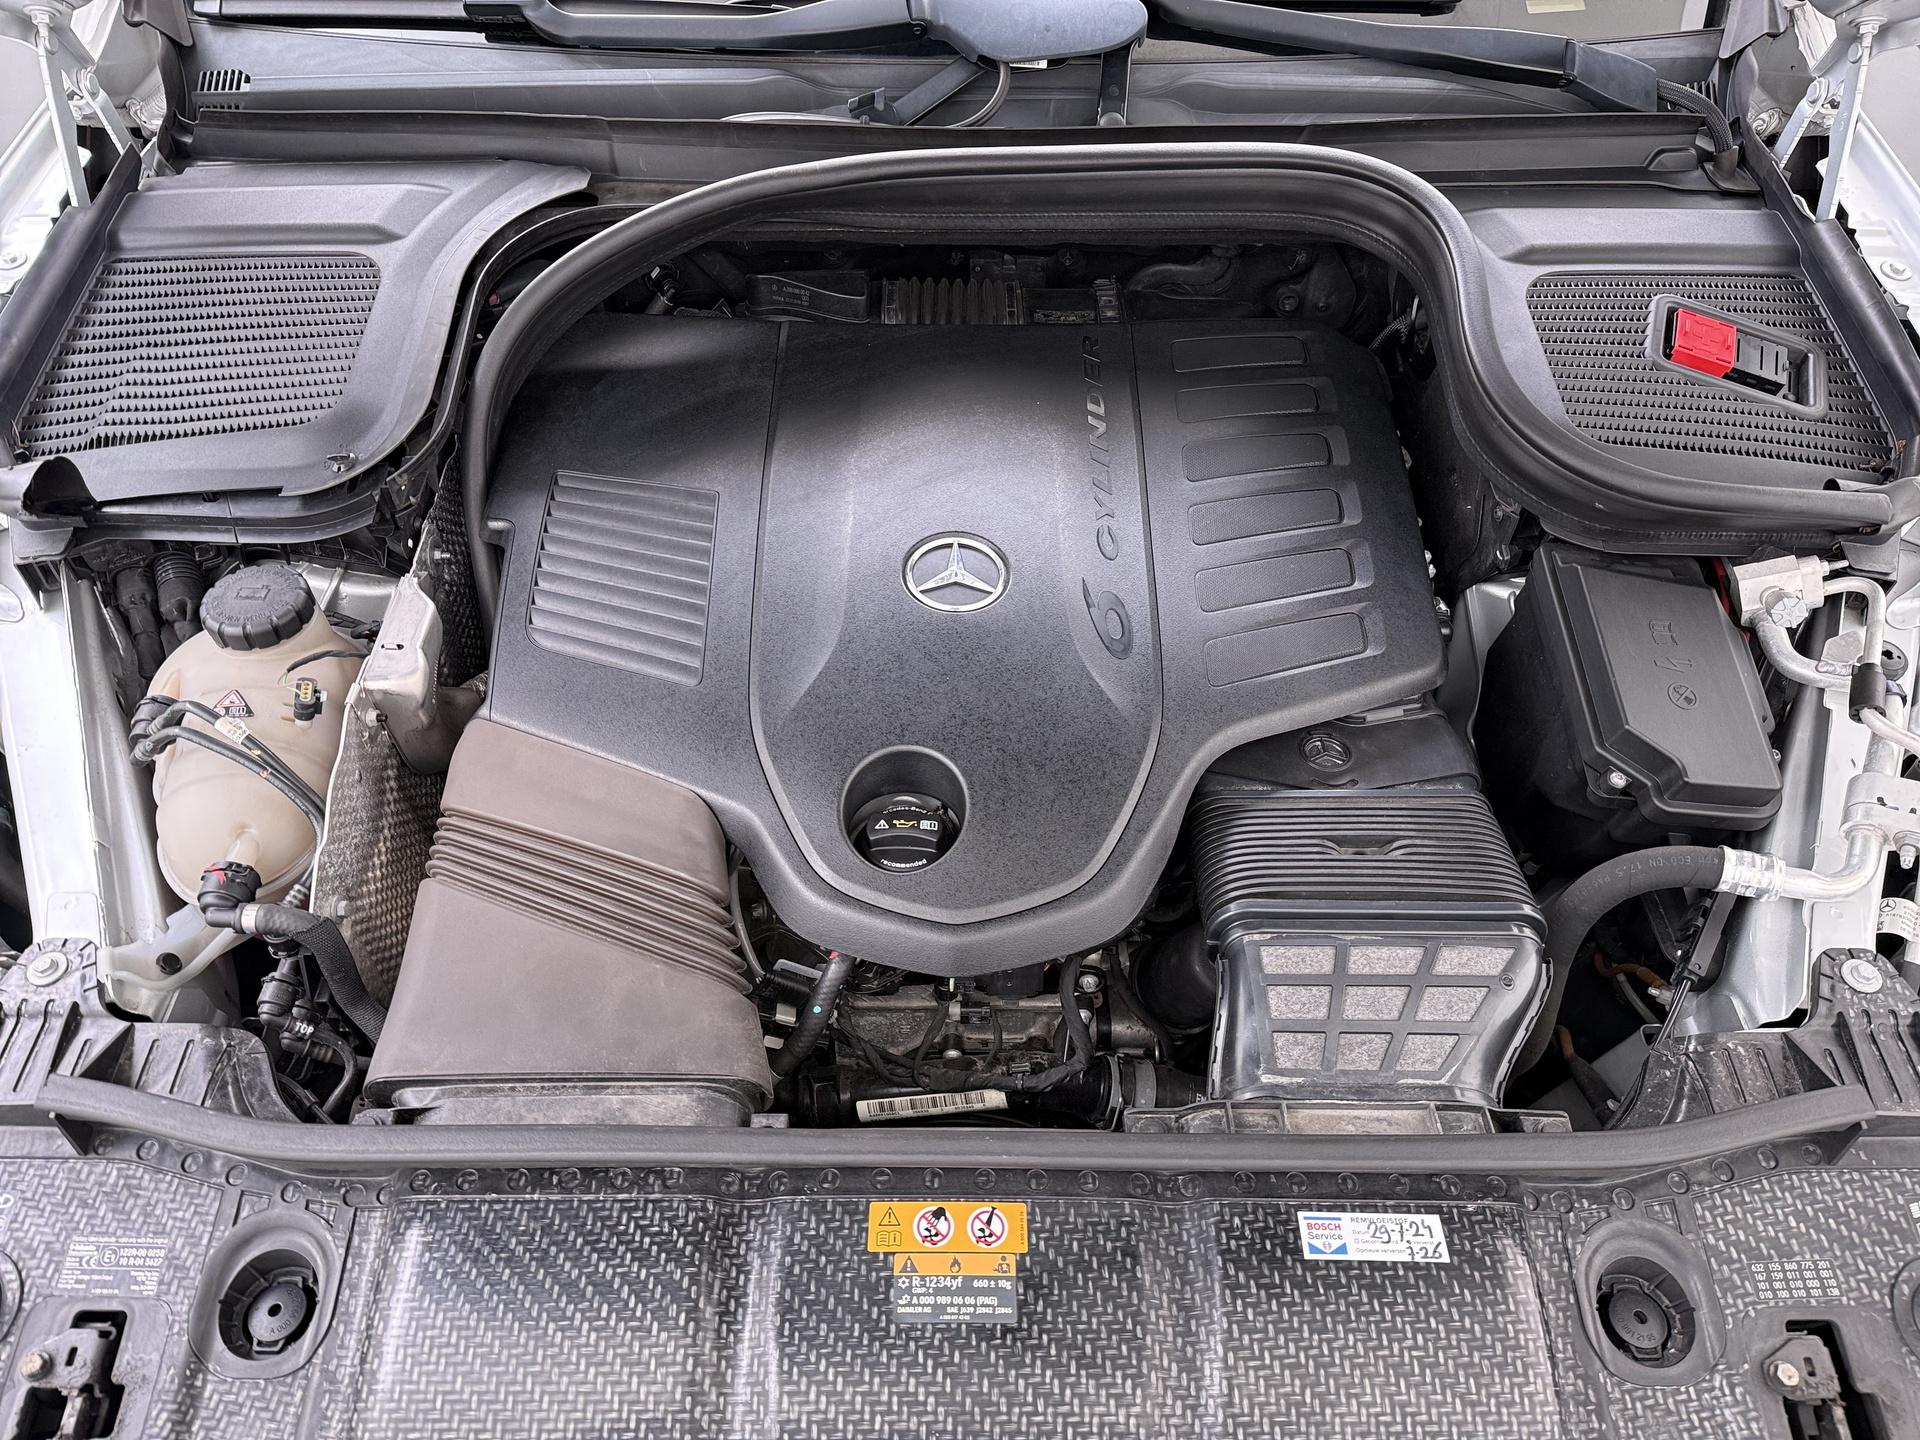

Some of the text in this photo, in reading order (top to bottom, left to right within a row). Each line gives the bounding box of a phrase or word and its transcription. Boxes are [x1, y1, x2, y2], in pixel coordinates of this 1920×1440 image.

[1081, 334, 1134, 660] 6 CYLINDER
[880, 858, 928, 868] recommended
[295, 1022, 314, 1035] TOP
[1307, 1222, 1341, 1231] BOSCH
[1307, 1232, 1343, 1241] Service
[1751, 1264, 1764, 1272] 632
[1768, 1263, 1781, 1271] 155
[1817, 1261, 1831, 1269] 201
[1771, 1272, 1783, 1280] 159
[1787, 1271, 1800, 1279] 011
[1820, 1270, 1833, 1278] 001
[912, 1276, 963, 1290] R-1234yf
[973, 1279, 988, 1288] 660
[998, 1279, 1012, 1290] 10g
[1757, 1282, 1769, 1290] 101
[1773, 1281, 1786, 1289] 001
[1806, 1280, 1820, 1288] 000
[1823, 1279, 1837, 1287] 110
[1759, 1291, 1773, 1299] 010
[1776, 1290, 1789, 1298] 100
[977, 1296, 998, 1306] (PAG)
